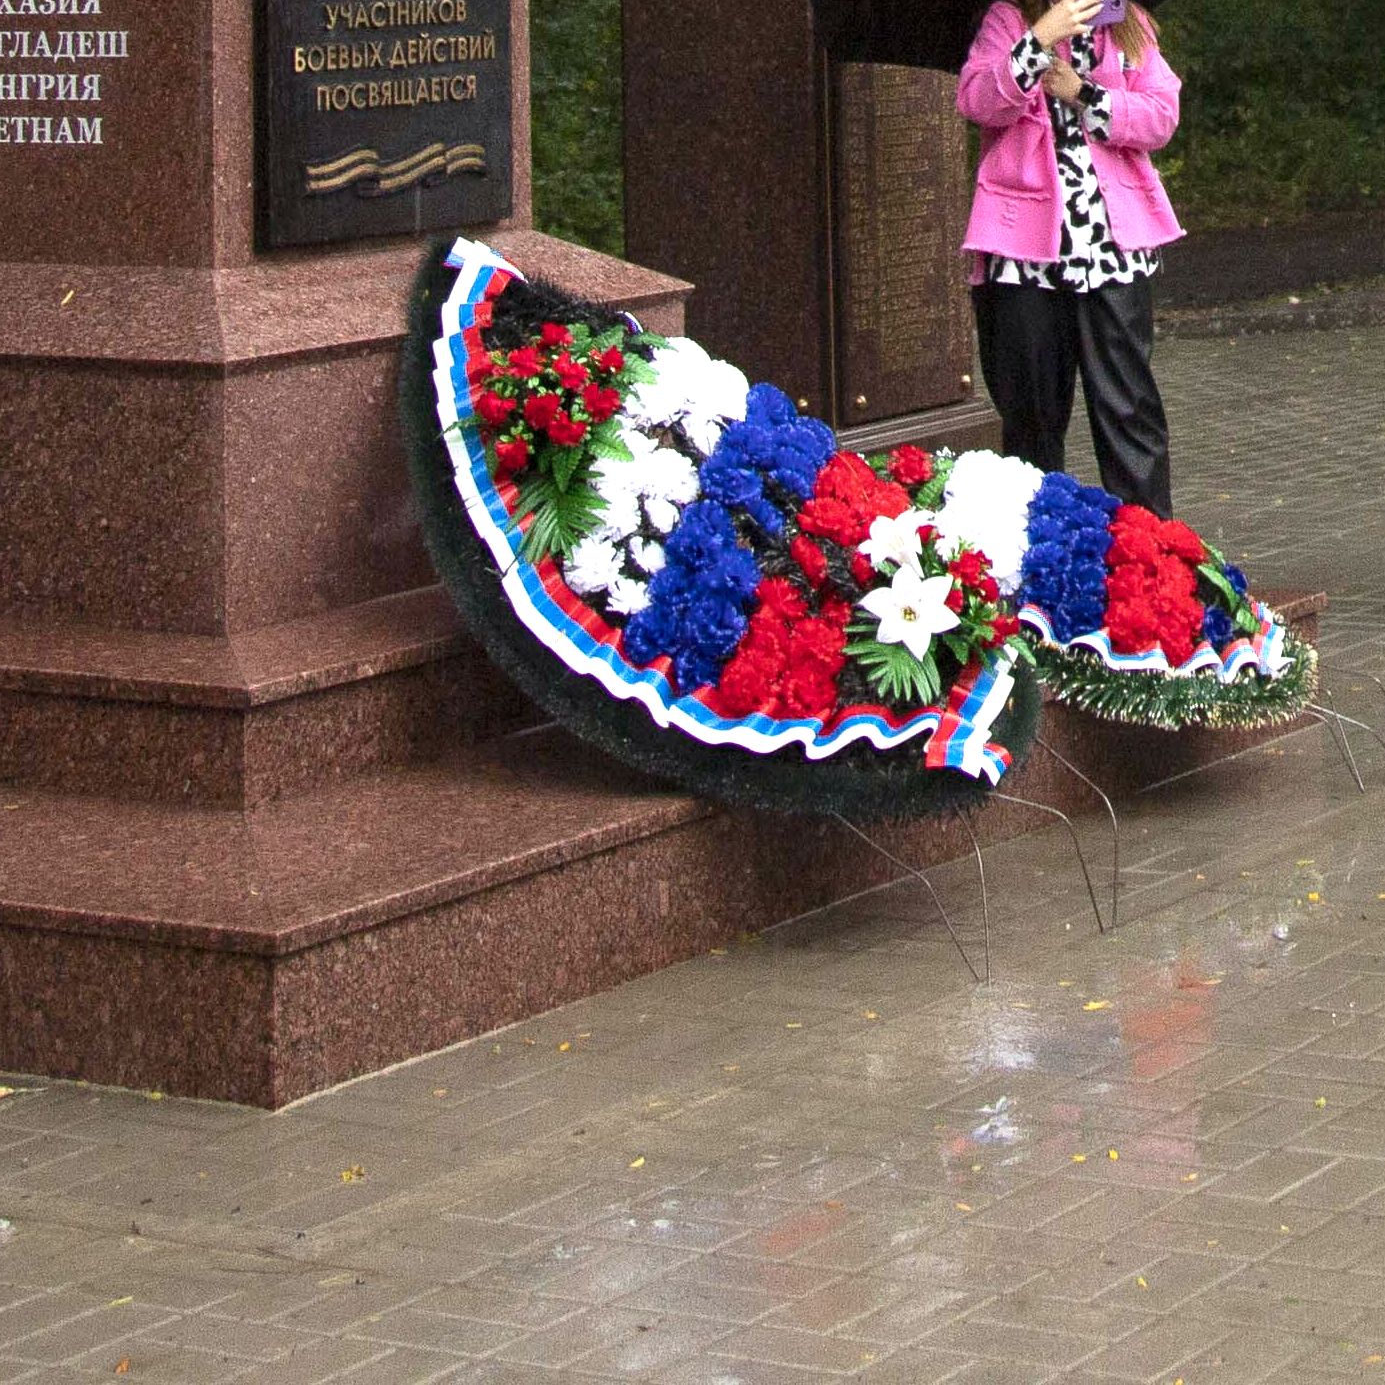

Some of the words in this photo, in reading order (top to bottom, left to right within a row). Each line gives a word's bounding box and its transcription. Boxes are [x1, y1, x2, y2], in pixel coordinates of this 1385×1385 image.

[294, 40, 384, 73] БОЕВЫХ
[389, 29, 496, 68] ДЕЙСТВИЙ
[316, 74, 478, 112] ПОСВЯЩАЕТСЯ
